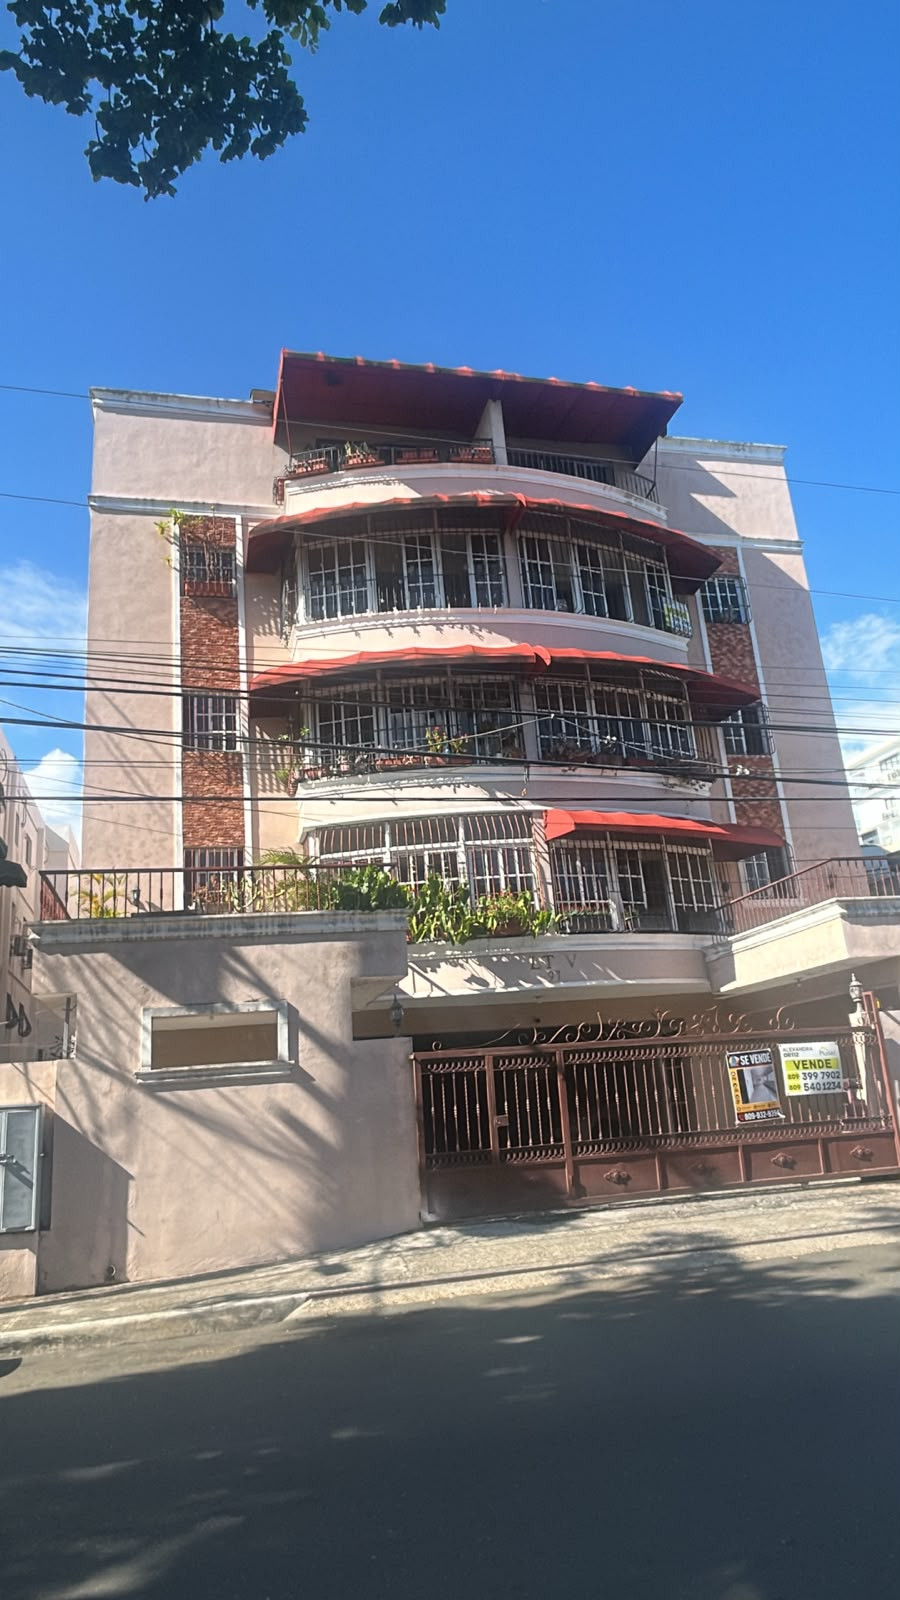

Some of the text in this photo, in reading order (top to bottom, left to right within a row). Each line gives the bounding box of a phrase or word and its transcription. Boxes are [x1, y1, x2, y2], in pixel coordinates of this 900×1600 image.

[740, 1052, 772, 1066] SE VENDE
[793, 1058, 833, 1070] VENDE
[801, 1071, 818, 1081] 399
[820, 1070, 841, 1080] 7902
[803, 1081, 821, 1092] 540
[822, 1080, 842, 1091] 1234
